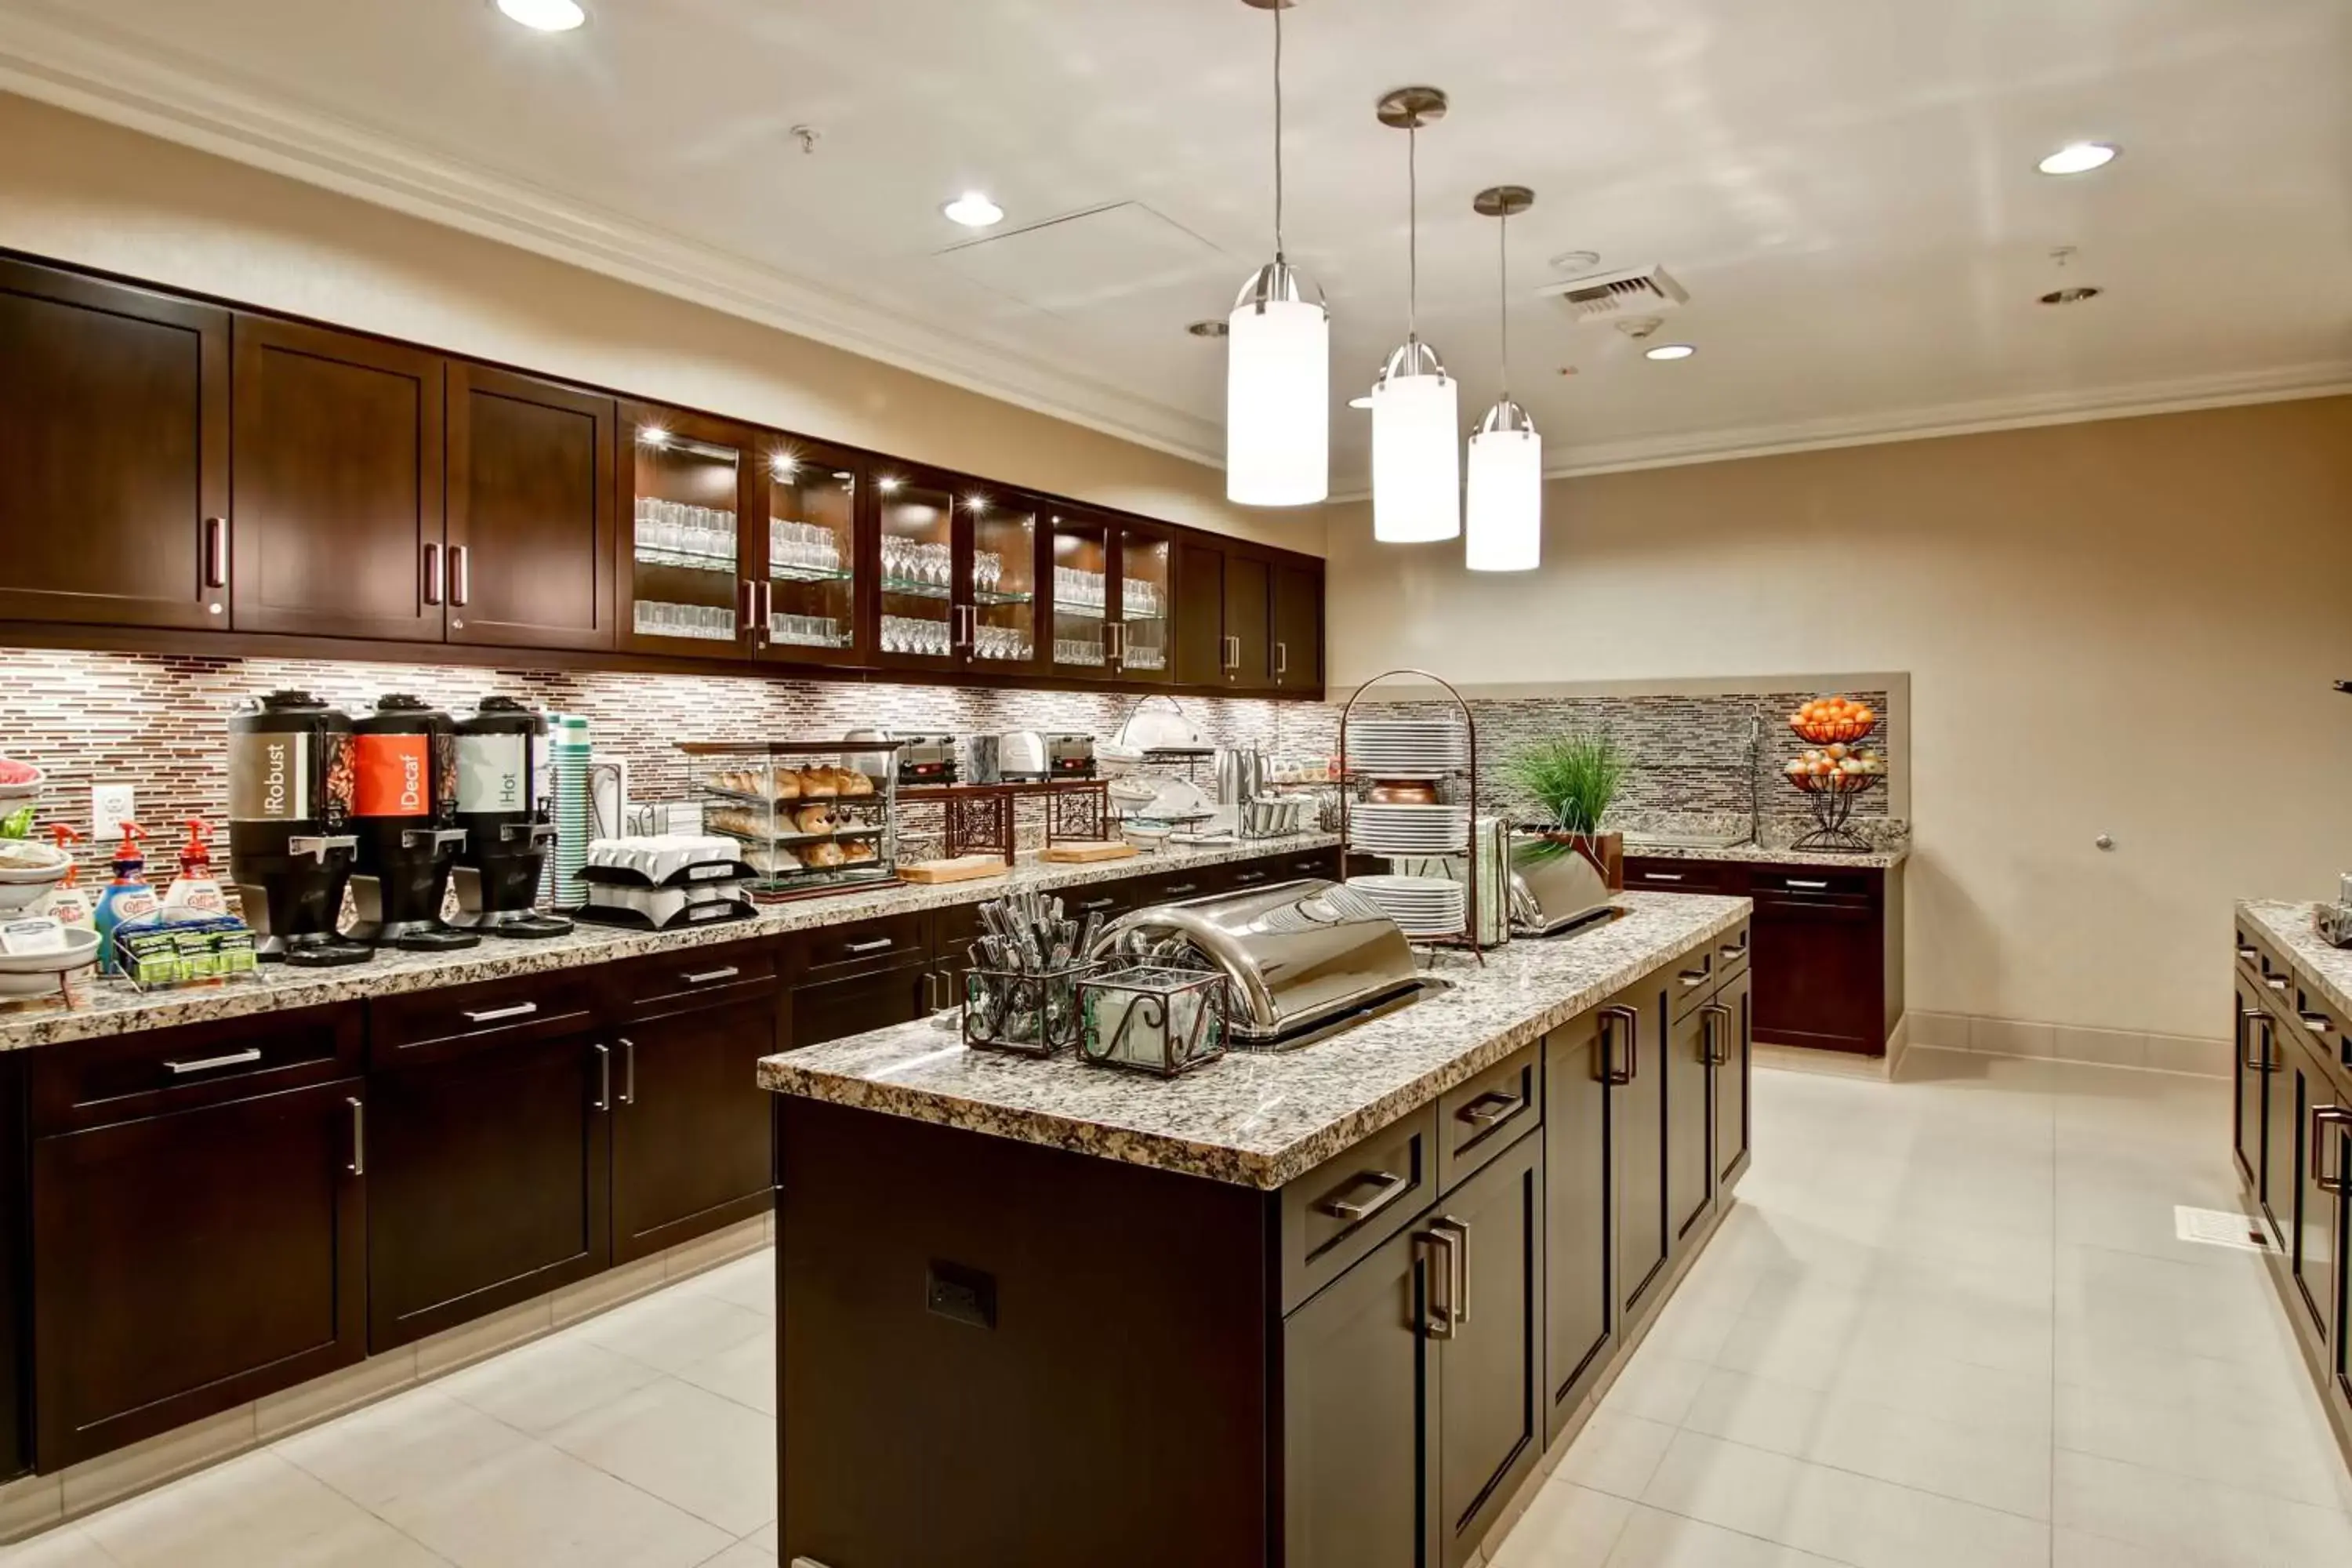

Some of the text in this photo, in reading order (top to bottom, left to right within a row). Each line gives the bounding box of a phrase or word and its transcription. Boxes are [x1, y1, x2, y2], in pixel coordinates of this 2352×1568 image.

[263, 743, 285, 809] Robust
[398, 753, 420, 805] Decaf
[499, 773, 515, 802] Hot
